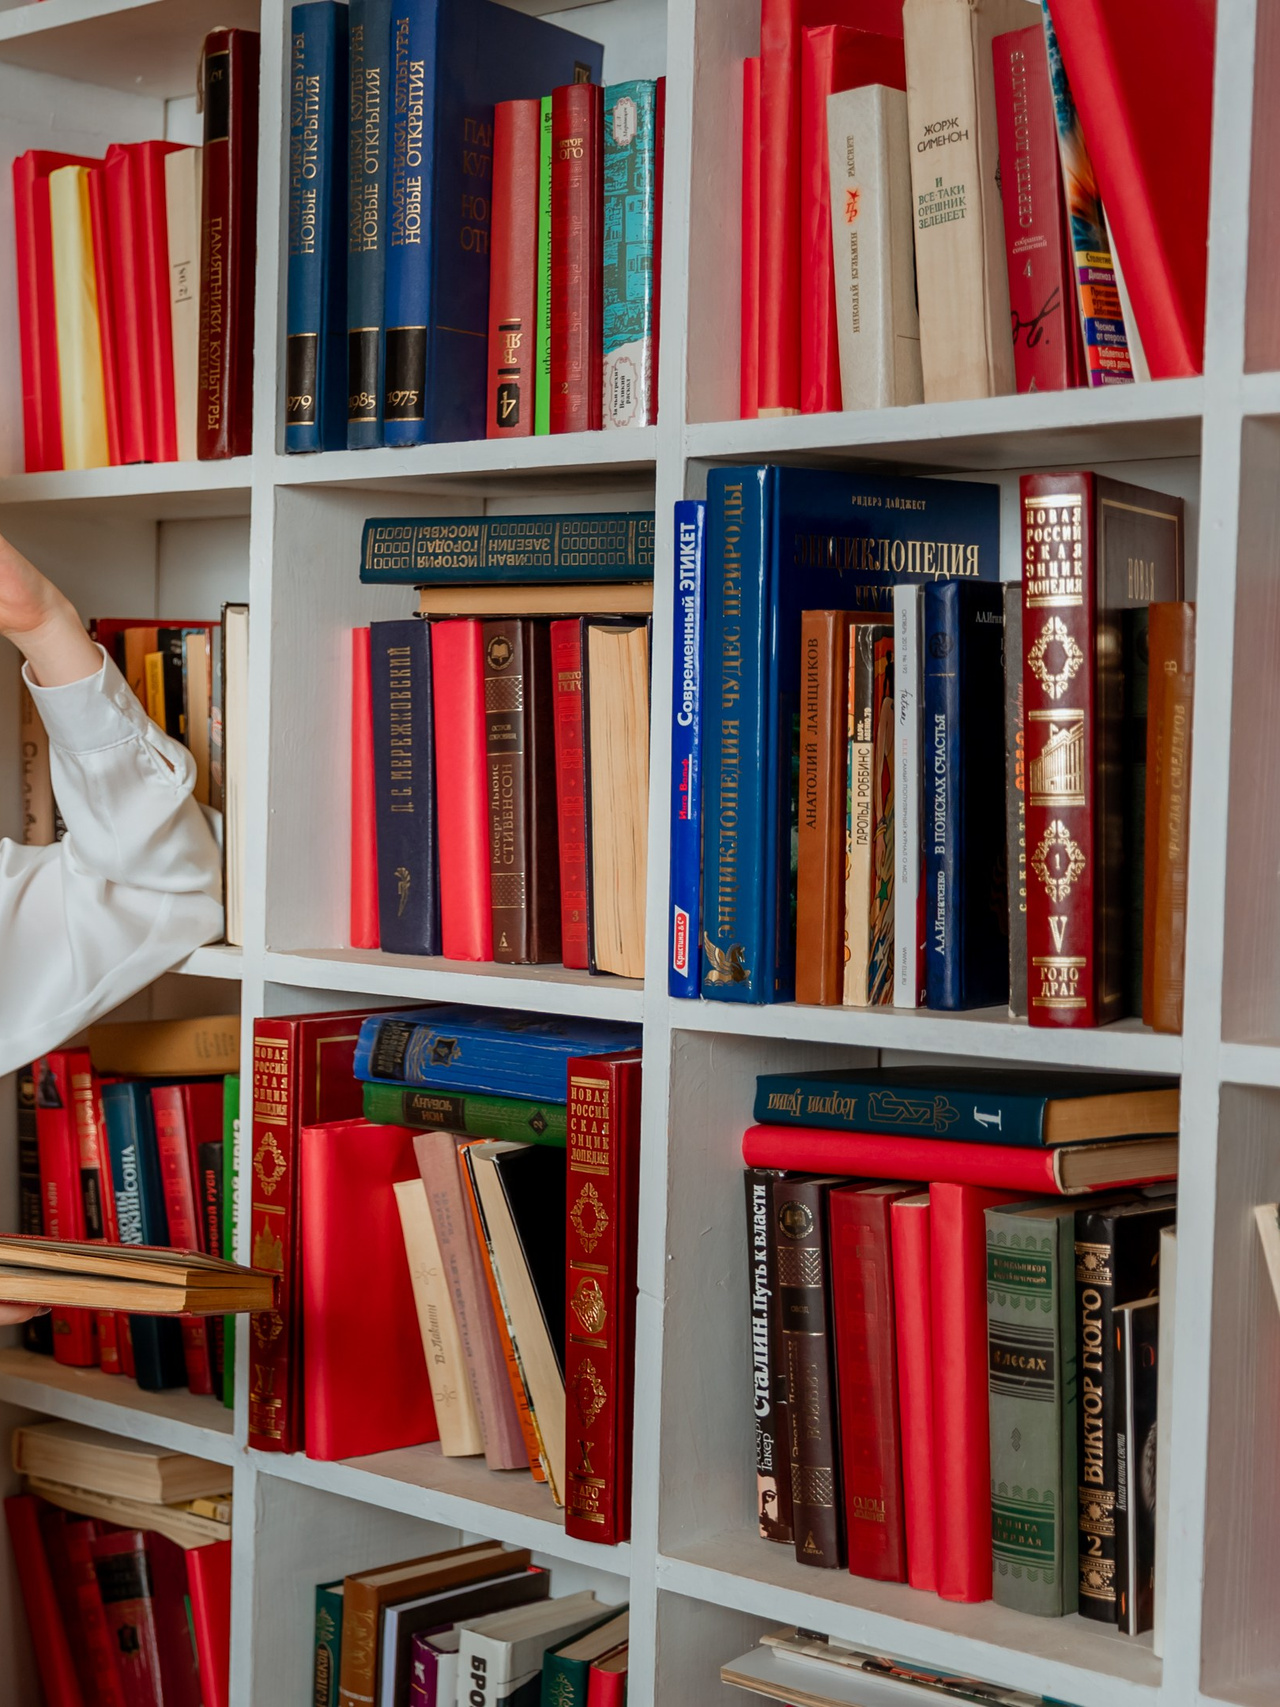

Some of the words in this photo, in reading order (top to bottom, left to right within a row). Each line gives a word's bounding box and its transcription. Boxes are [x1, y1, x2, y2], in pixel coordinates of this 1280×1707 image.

[351, 25, 364, 122] КУЛЬТУРЫ
[395, 17, 410, 116] КУЛЬТУРЫ
[407, 60, 425, 167] ОТКРЫТИЯ
[1010, 50, 1031, 150] ДОВЛАТОВ
[302, 75, 320, 179] ОТКРЫТИЯ
[364, 67, 380, 174] ОТКРЫТИЯ
[923, 117, 959, 137] ЖОРЖ
[847, 135, 856, 177] РАССВЕТ
[917, 130, 969, 153] СИМЕНОН
[349, 128, 363, 253] ПАМЯТНИКИ
[392, 120, 406, 247] ПАМЯТНИКИ
[918, 185, 965, 205] ВСЕ-ТАКИ
[935, 176, 943, 188] И
[1019, 159, 1033, 229] СЕРГЕЙ
[300, 188, 317, 254] НОВЫЕ
[362, 183, 379, 252] НОВЫЕ
[405, 175, 422, 245] НОВЫЕ
[918, 197, 966, 217] ОРЕШНИК
[919, 208, 967, 229] ЗЕЛЕНЕЕТ
[851, 232, 859, 279] КУЗЬМИН
[1023, 259, 1033, 277] 4
[210, 217, 222, 333] ПАМЯТНИКИ
[850, 284, 861, 333] НИКОЛАЙ
[1095, 320, 1115, 332] Чеснок
[208, 341, 221, 430] КУЛЬТУРЫ
[386, 390, 419, 407] 1975
[561, 382, 569, 395] 2
[501, 391, 517, 419] 4
[851, 495, 882, 507] РИДЕРЗ
[884, 497, 926, 511] ДАЙДЖЕСТ
[1026, 508, 1082, 526] НОВАЯ
[418, 524, 479, 538] МОСКВЫ
[427, 539, 478, 553] ГОРОДА
[488, 537, 551, 553] ЗАБЕЛИН
[724, 482, 744, 617] ПРИРОДЫ
[1026, 521, 1082, 542] РОССИЙ
[417, 555, 477, 568] ИСТОРИЯ
[488, 554, 525, 566] ИВАН
[679, 522, 696, 592] ЭТИКЕТ
[794, 533, 979, 582] ЭНЦИКЛОПЕДИЯ
[1026, 543, 1082, 560] СКАЯ
[1026, 561, 1083, 579] ЭНЦИК
[1027, 578, 1083, 596] ЛОПЕДИЯ
[677, 596, 696, 727] Современный
[722, 625, 742, 712] ЧУДЕС
[807, 638, 819, 736] ЛАНЩИКОВ
[387, 646, 413, 780] МЕРЕЖКОВСКИЙ
[934, 714, 946, 774] СЧАСТЬЯ
[1171, 704, 1186, 789] СМЕЛЯКОВ
[491, 764, 500, 811] Льюис
[805, 743, 818, 830] АНАТОЛИЙ
[857, 748, 870, 796] РОББИНС
[502, 764, 514, 865] СТИВЕНСОН
[856, 801, 870, 845] ГАРОЛЬД
[934, 776, 946, 842] ПОИСКАХ
[493, 815, 502, 864] Роберт
[718, 719, 741, 939] ЭНЦИКЛОПЕДИЯ
[935, 846, 946, 855] В
[1054, 852, 1061, 871] 1
[934, 871, 946, 956] А.А.Игнатенко
[674, 932, 686, 966] Кристина
[1048, 915, 1068, 953] V
[1041, 967, 1079, 982] ГОЛО
[1041, 981, 1077, 997] ДРАГ
[254, 1045, 288, 1061] НОВАЯ
[254, 1059, 288, 1075] РОССИЙ
[254, 1074, 288, 1089] СКАЯ
[254, 1088, 288, 1102] ЭНЦИК
[571, 1087, 609, 1104] НОВАЯ
[571, 1102, 609, 1119] РОССИЙ
[767, 1087, 804, 1117] Гулиа
[807, 1090, 858, 1121] Георгий
[973, 1106, 1002, 1132] 1
[571, 1118, 609, 1134] СКАЯ
[571, 1133, 609, 1150] ЭНЦИК
[571, 1148, 609, 1165] ЛОПЕДИЯ
[121, 1144, 144, 1245] АРКИНСОНА
[205, 1169, 218, 1203] РУСИ
[206, 1205, 220, 1258] ОВСКОЙ
[752, 1184, 768, 1246] власти
[755, 1248, 767, 1261] к
[753, 1265, 773, 1311] Путь
[1082, 1288, 1103, 1372] ГЮГО
[752, 1311, 771, 1418] Сталин.
[1002, 1353, 1047, 1371] ЛЕСАХ
[1083, 1376, 1104, 1485] ВИКТОР
[1116, 1433, 1126, 1459] света
[761, 1432, 774, 1471] Такер
[1087, 1535, 1103, 1558] 2
